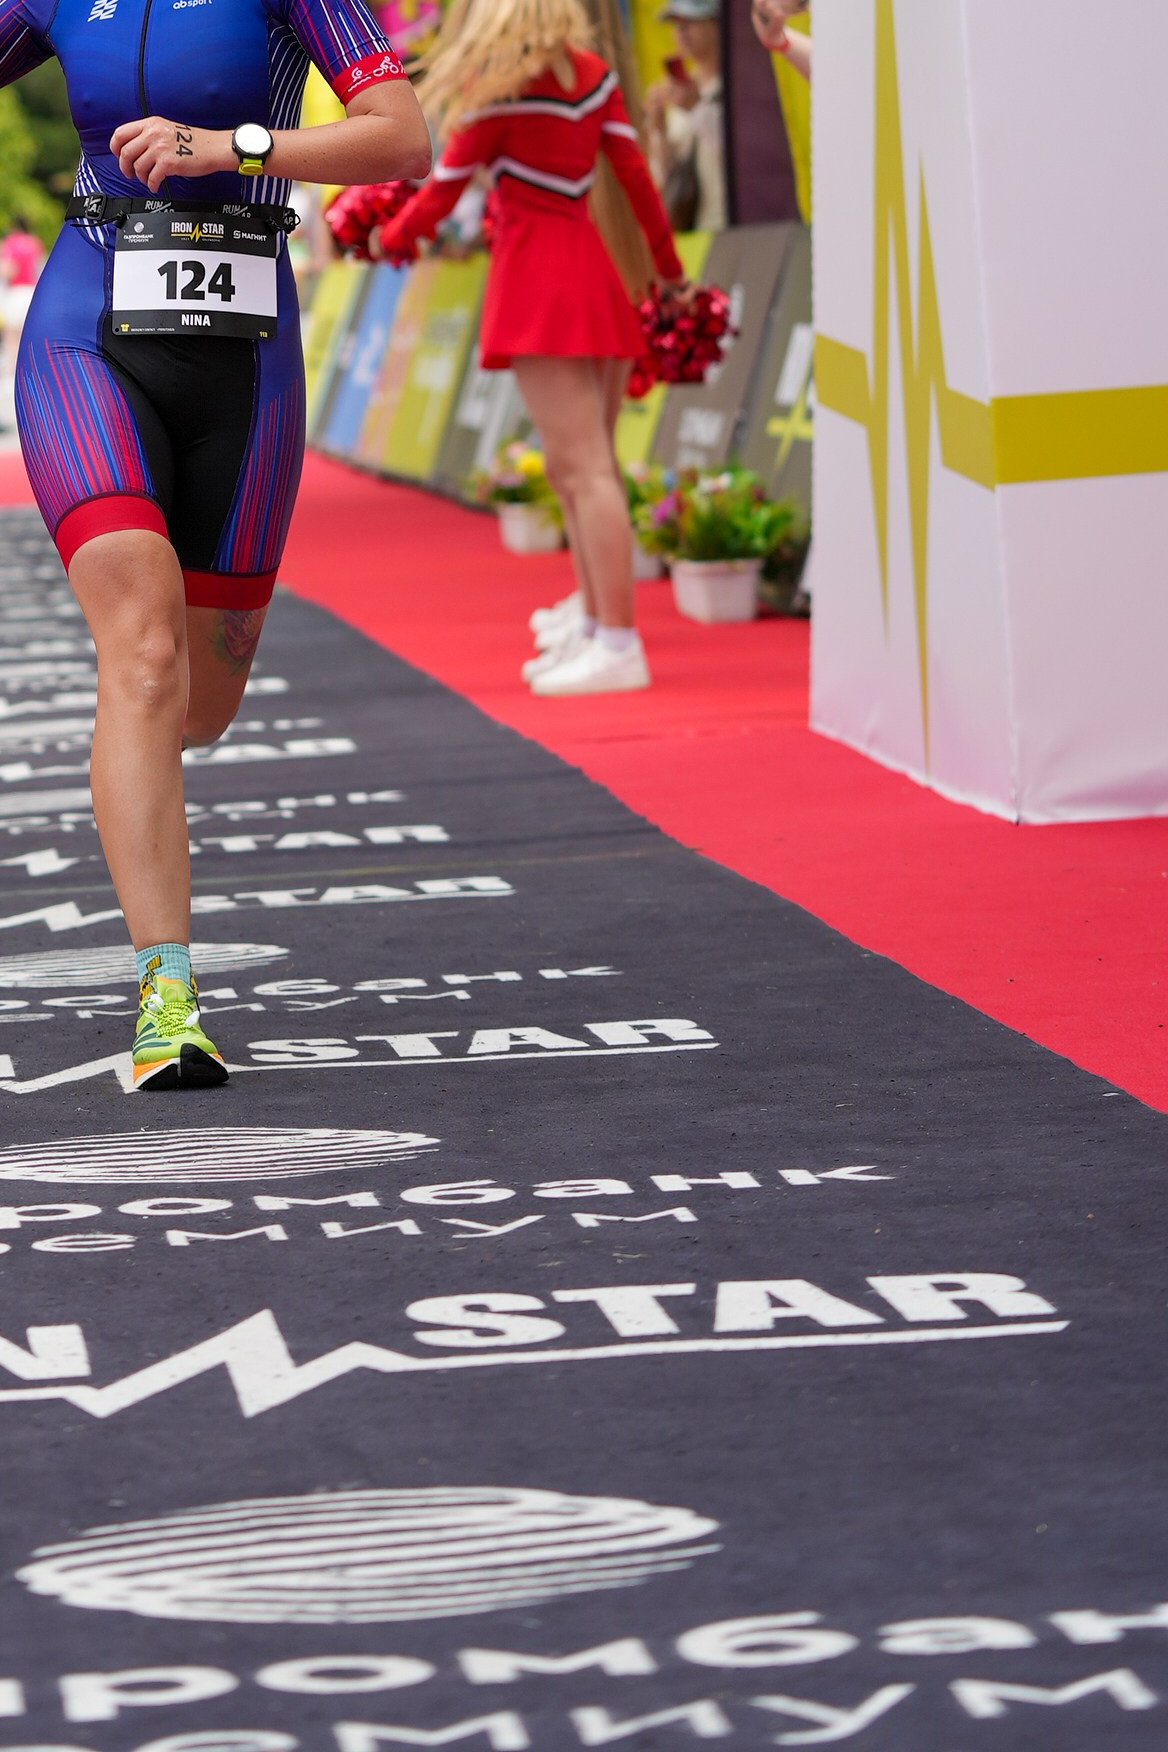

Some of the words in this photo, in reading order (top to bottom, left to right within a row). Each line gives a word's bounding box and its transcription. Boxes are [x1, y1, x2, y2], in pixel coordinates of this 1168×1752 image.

[175, 124, 194, 158] 124
[171, 221, 193, 234] IRON
[202, 223, 224, 235] STAR
[241, 231, 267, 242] МАГНИТ
[157, 260, 236, 303] 124
[181, 314, 211, 327] NINA
[189, 824, 451, 855] TAR
[247, 1017, 715, 1063] STAR
[405, 1271, 1061, 1349] STAR
